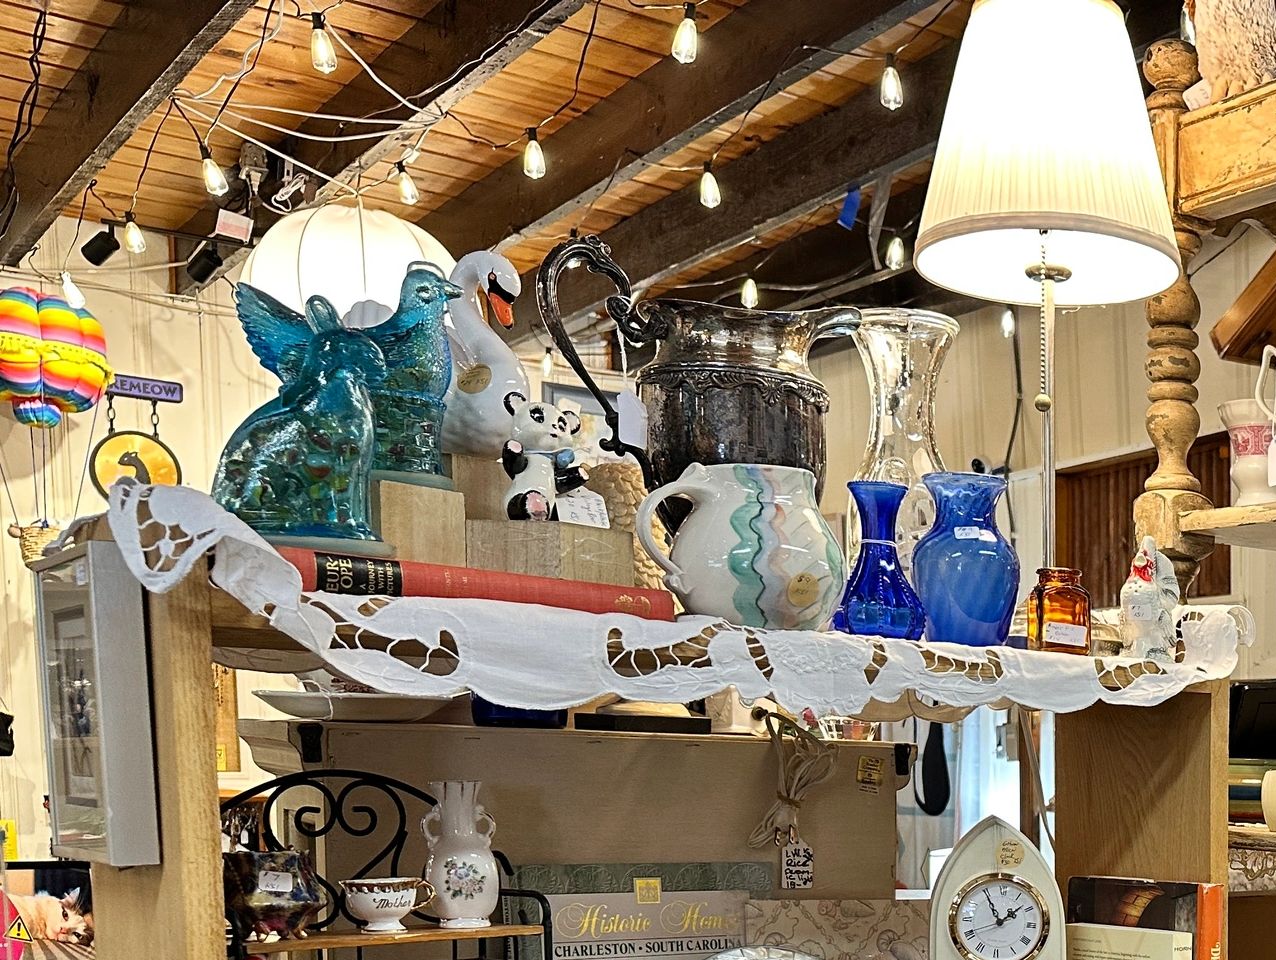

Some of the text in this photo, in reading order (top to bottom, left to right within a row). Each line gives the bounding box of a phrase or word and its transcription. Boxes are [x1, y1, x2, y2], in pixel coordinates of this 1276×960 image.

[373, 896, 412, 910] Mother
[555, 902, 651, 939] Historic
[554, 938, 742, 958] CHARLESTON SOUTH CAROLINA
